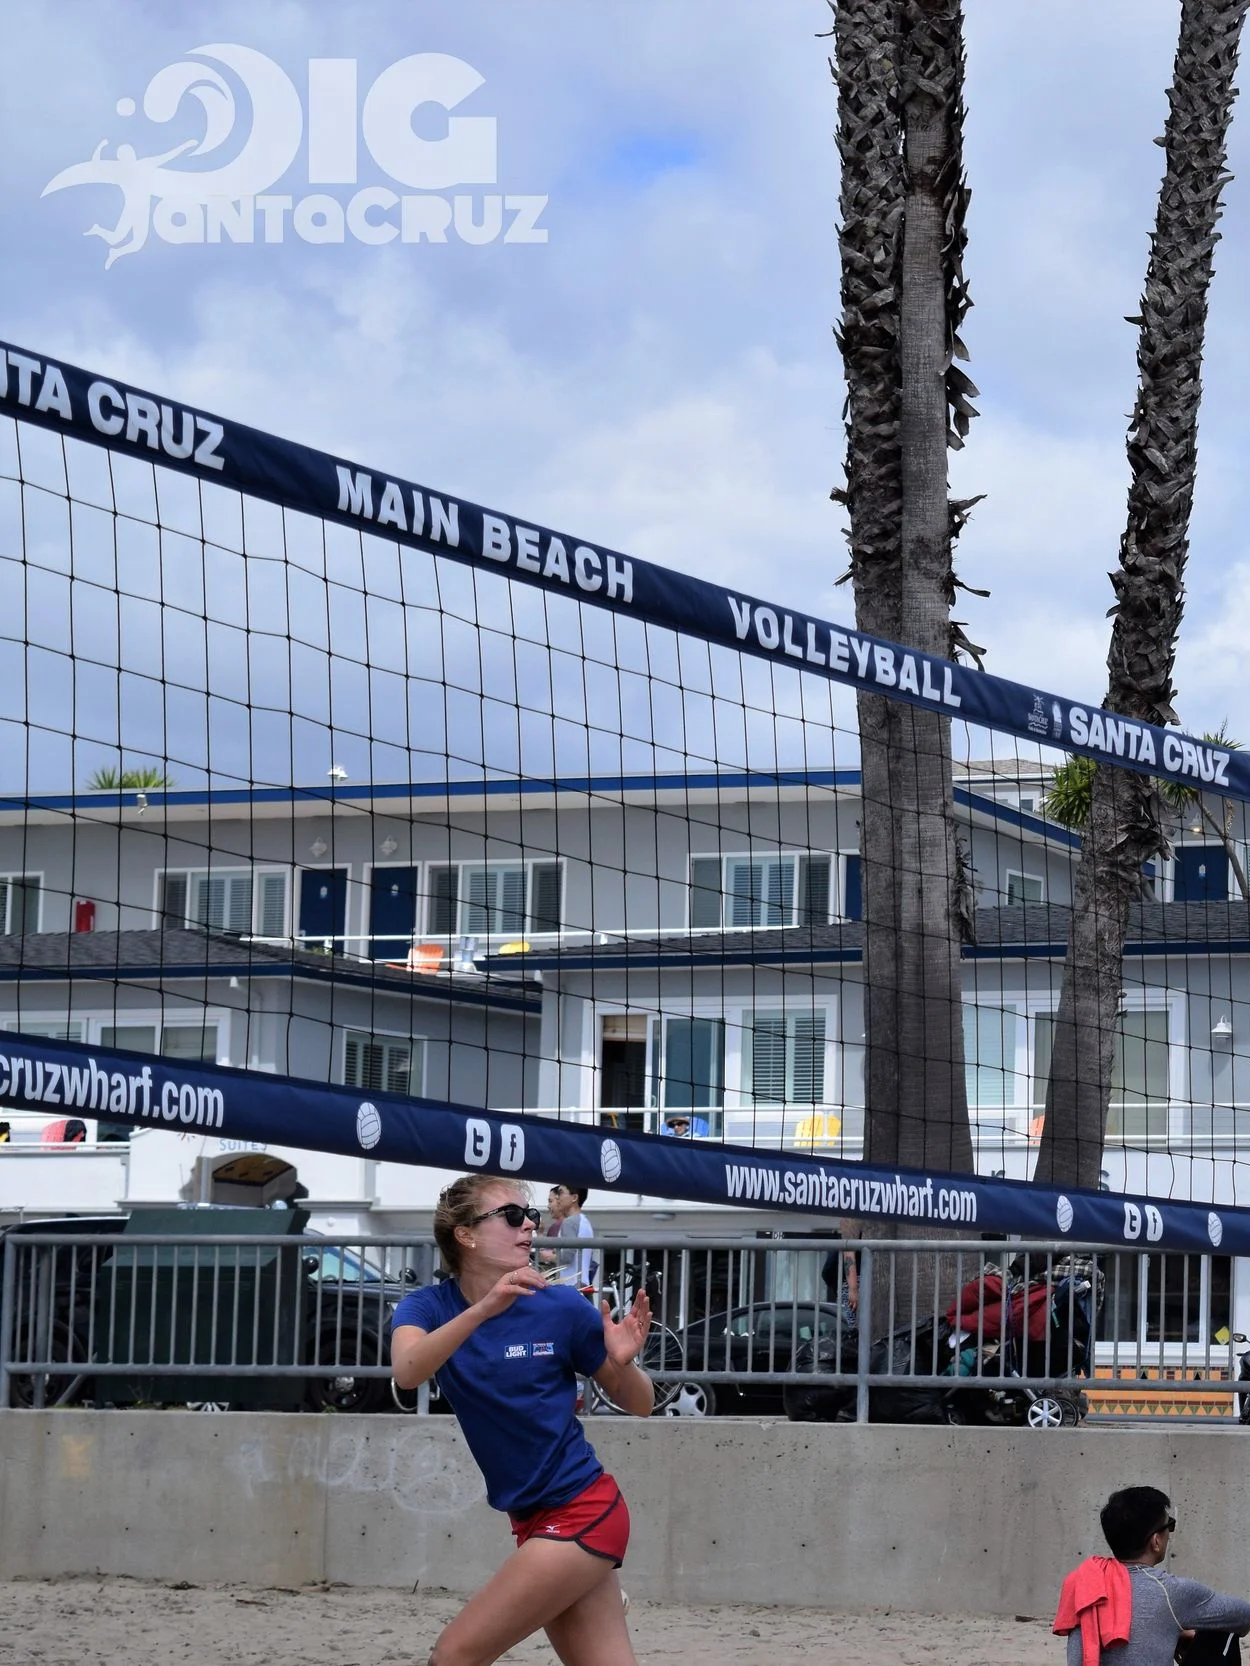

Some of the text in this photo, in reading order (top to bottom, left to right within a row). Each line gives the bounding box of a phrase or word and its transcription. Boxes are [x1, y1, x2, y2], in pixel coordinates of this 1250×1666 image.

[87, 381, 225, 471] CRUZ
[335, 465, 460, 548] MAIN
[482, 513, 633, 603] BEACH
[727, 596, 962, 708] VOLLEYBALL
[1069, 706, 1156, 765] SANTA
[1163, 735, 1229, 787] CRUZ
[725, 1164, 977, 1222] www.santacruzwharf.com
[505, 1350, 527, 1358] LIGHT
